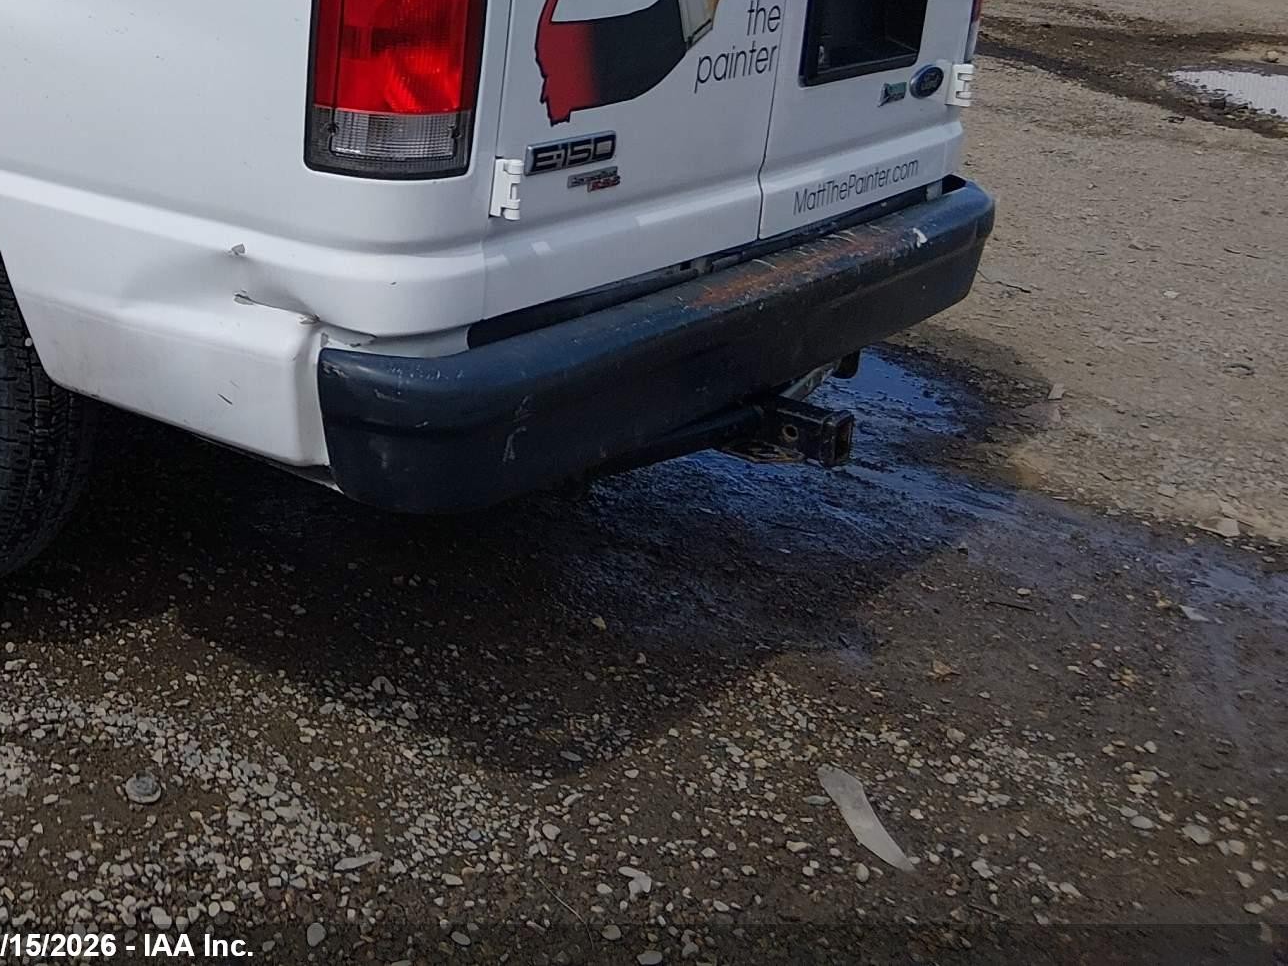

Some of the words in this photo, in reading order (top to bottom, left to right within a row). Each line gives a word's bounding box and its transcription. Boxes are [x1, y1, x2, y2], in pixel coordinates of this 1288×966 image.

[746, 0, 782, 37] the
[693, 42, 778, 94] painter
[792, 159, 919, 216] MattThePainter.com
